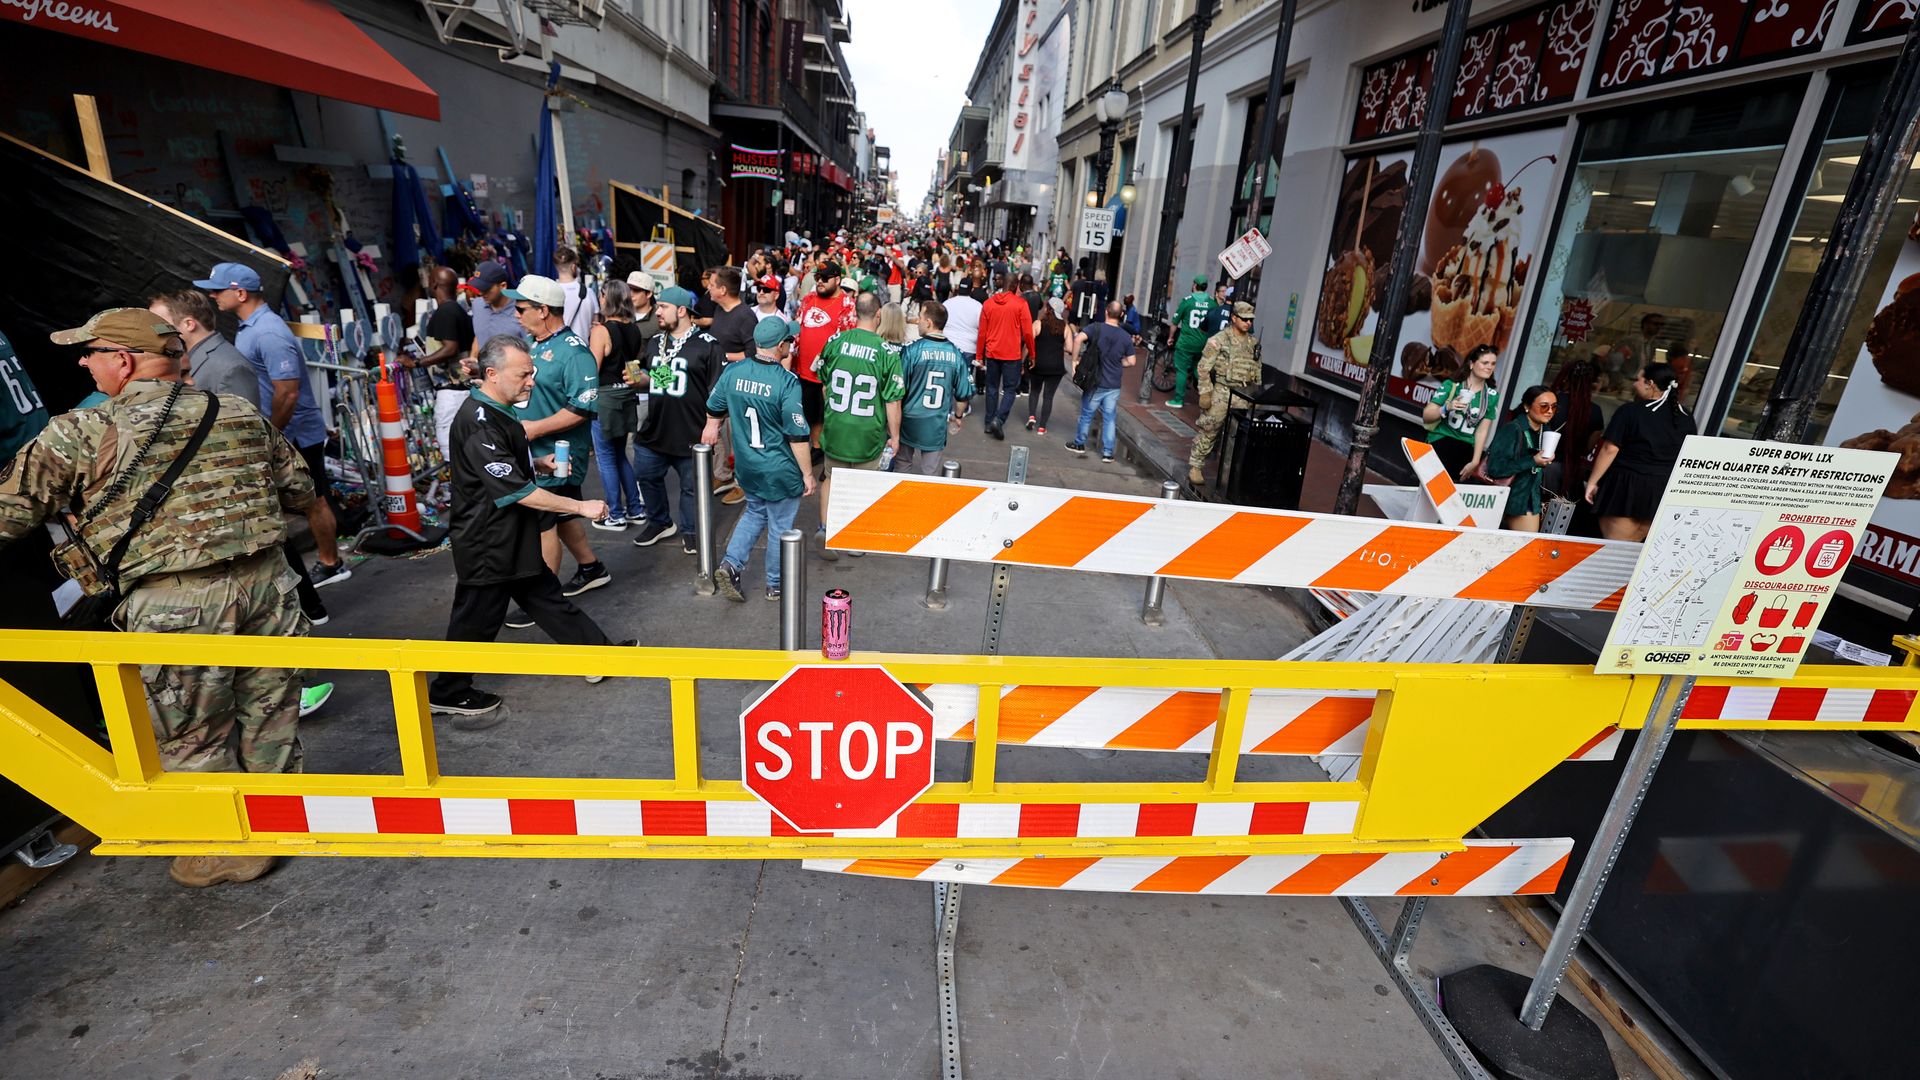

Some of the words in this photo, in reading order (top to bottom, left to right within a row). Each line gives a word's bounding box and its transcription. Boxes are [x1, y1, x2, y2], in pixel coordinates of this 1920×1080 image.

[0, 0, 119, 32] greens
[1012, 0, 1039, 154] rystal
[1084, 212, 1112, 221] SPEED
[1086, 230, 1105, 246] 15
[1113, 228, 1125, 237] TM
[840, 342, 878, 362] R.WHITE
[1343, 361, 1367, 383] APPLES
[735, 378, 772, 397] HURTS
[829, 368, 878, 417] 92
[922, 371, 945, 410] 5
[1412, 384, 1434, 404] CHOC
[745, 407, 765, 449] 1
[1748, 447, 1782, 459] SUPER
[1784, 450, 1814, 462] BOWL
[1816, 453, 1834, 463] LIX
[1679, 459, 1720, 471] FRENCH
[1722, 461, 1770, 475] QUARTER
[1771, 465, 1810, 477] SAFETY
[1810, 469, 1885, 484] RESTRICTIONS
[1780, 513, 1830, 524] PROHIBITED
[1831, 516, 1857, 526] ITEMS
[1744, 581, 1804, 591] DISCOURAGED
[1805, 583, 1830, 592] ITEMS
[1644, 652, 1691, 663] GOHSEP
[754, 720, 924, 781] STOP
